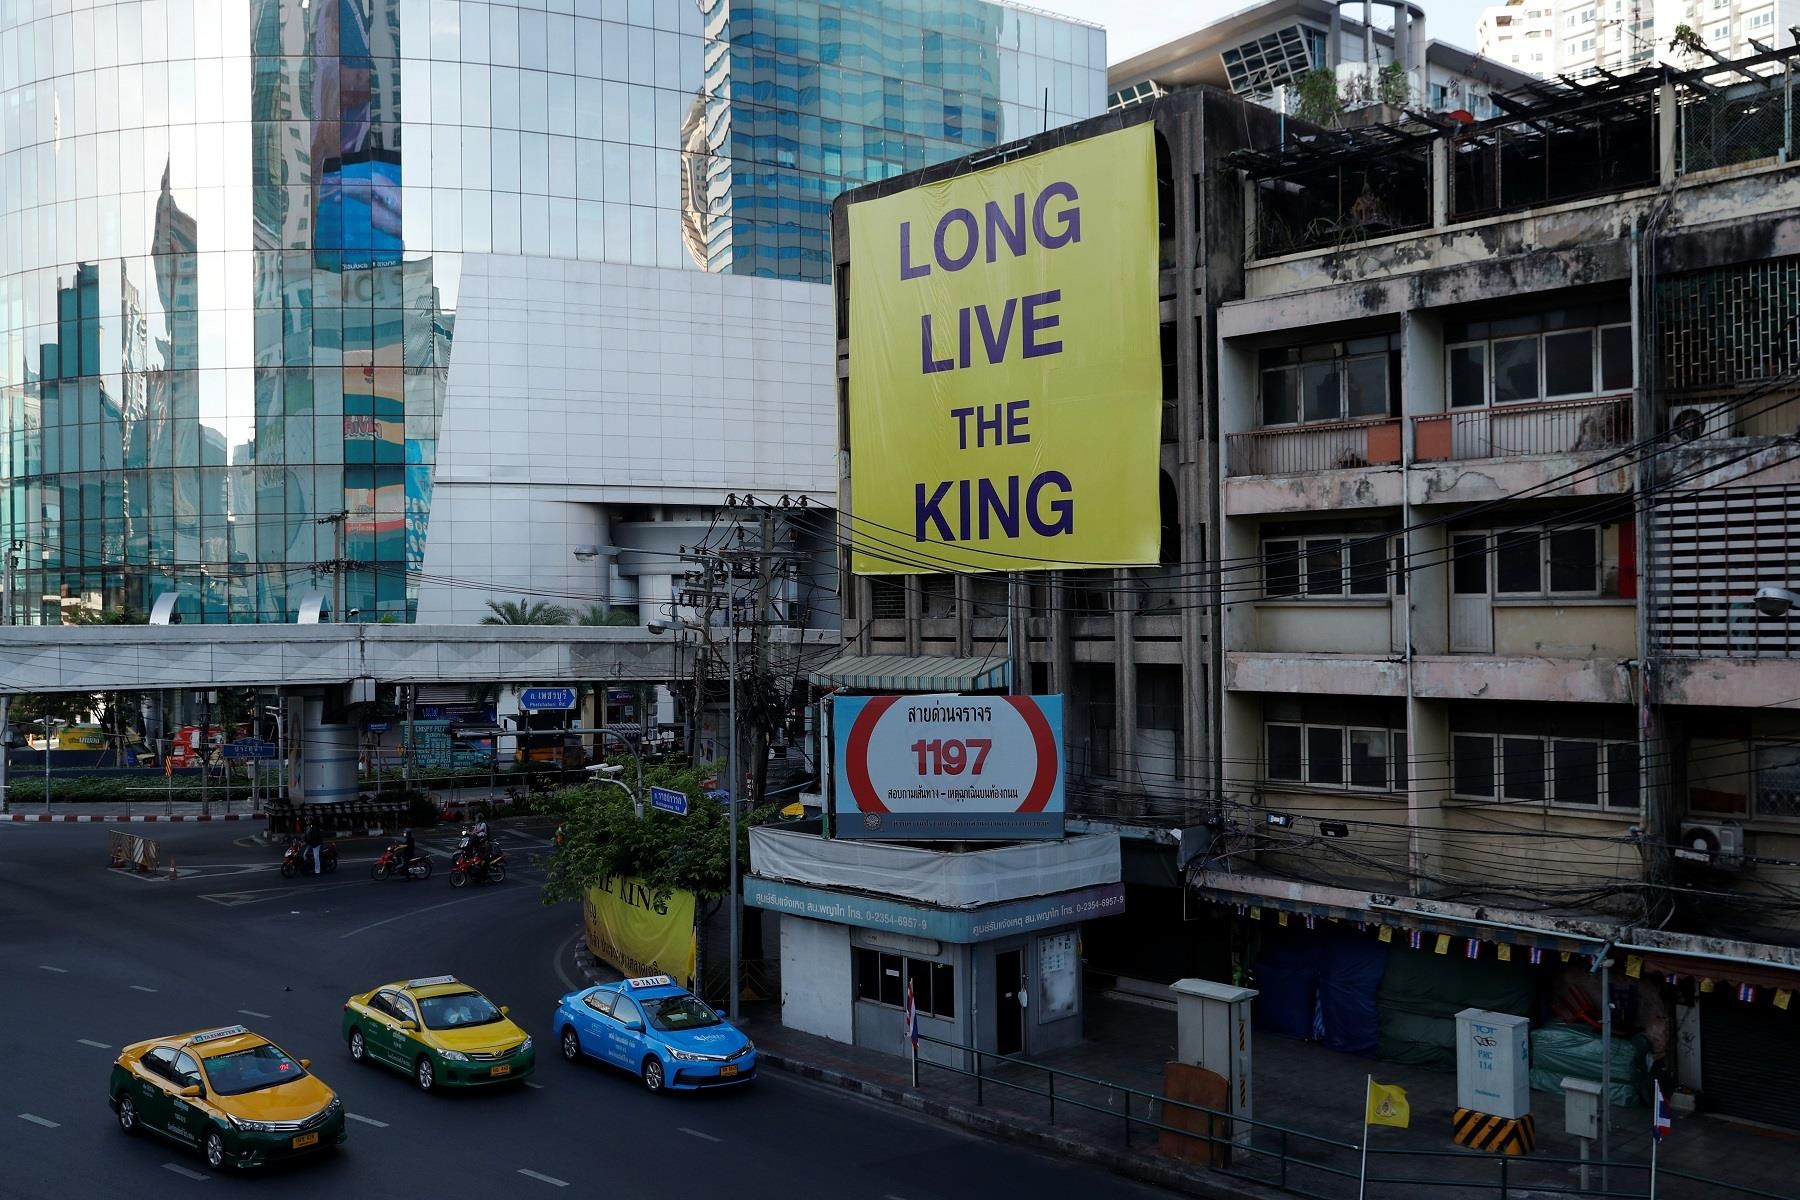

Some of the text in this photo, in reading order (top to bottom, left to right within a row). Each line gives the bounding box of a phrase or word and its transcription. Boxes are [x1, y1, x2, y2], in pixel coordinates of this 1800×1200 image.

[899, 181, 1082, 281] LONG
[921, 288, 1063, 374] LIVE
[951, 399, 1031, 450] THE
[915, 470, 1074, 543] KING
[908, 699, 992, 723] สายด่วนจราจร
[911, 738, 992, 775] 1197
[888, 784, 939, 800] สอบถามเส้นทาง
[947, 784, 1019, 803] เหตุฉุกเฉินบนท้องถนน
[620, 876, 669, 916] KING
[756, 893, 928, 930] ศูนย์รับแจ้งเหตุ สน.พญาไท โทร. 0-2354-6957-9
[973, 895, 1124, 936] ศูนย์รับแจ้งเหตุ สน.พญาไท โทร. 0-2354-6957-9
[640, 977, 661, 986] TAXI
[1472, 1024, 1497, 1034] TOT
